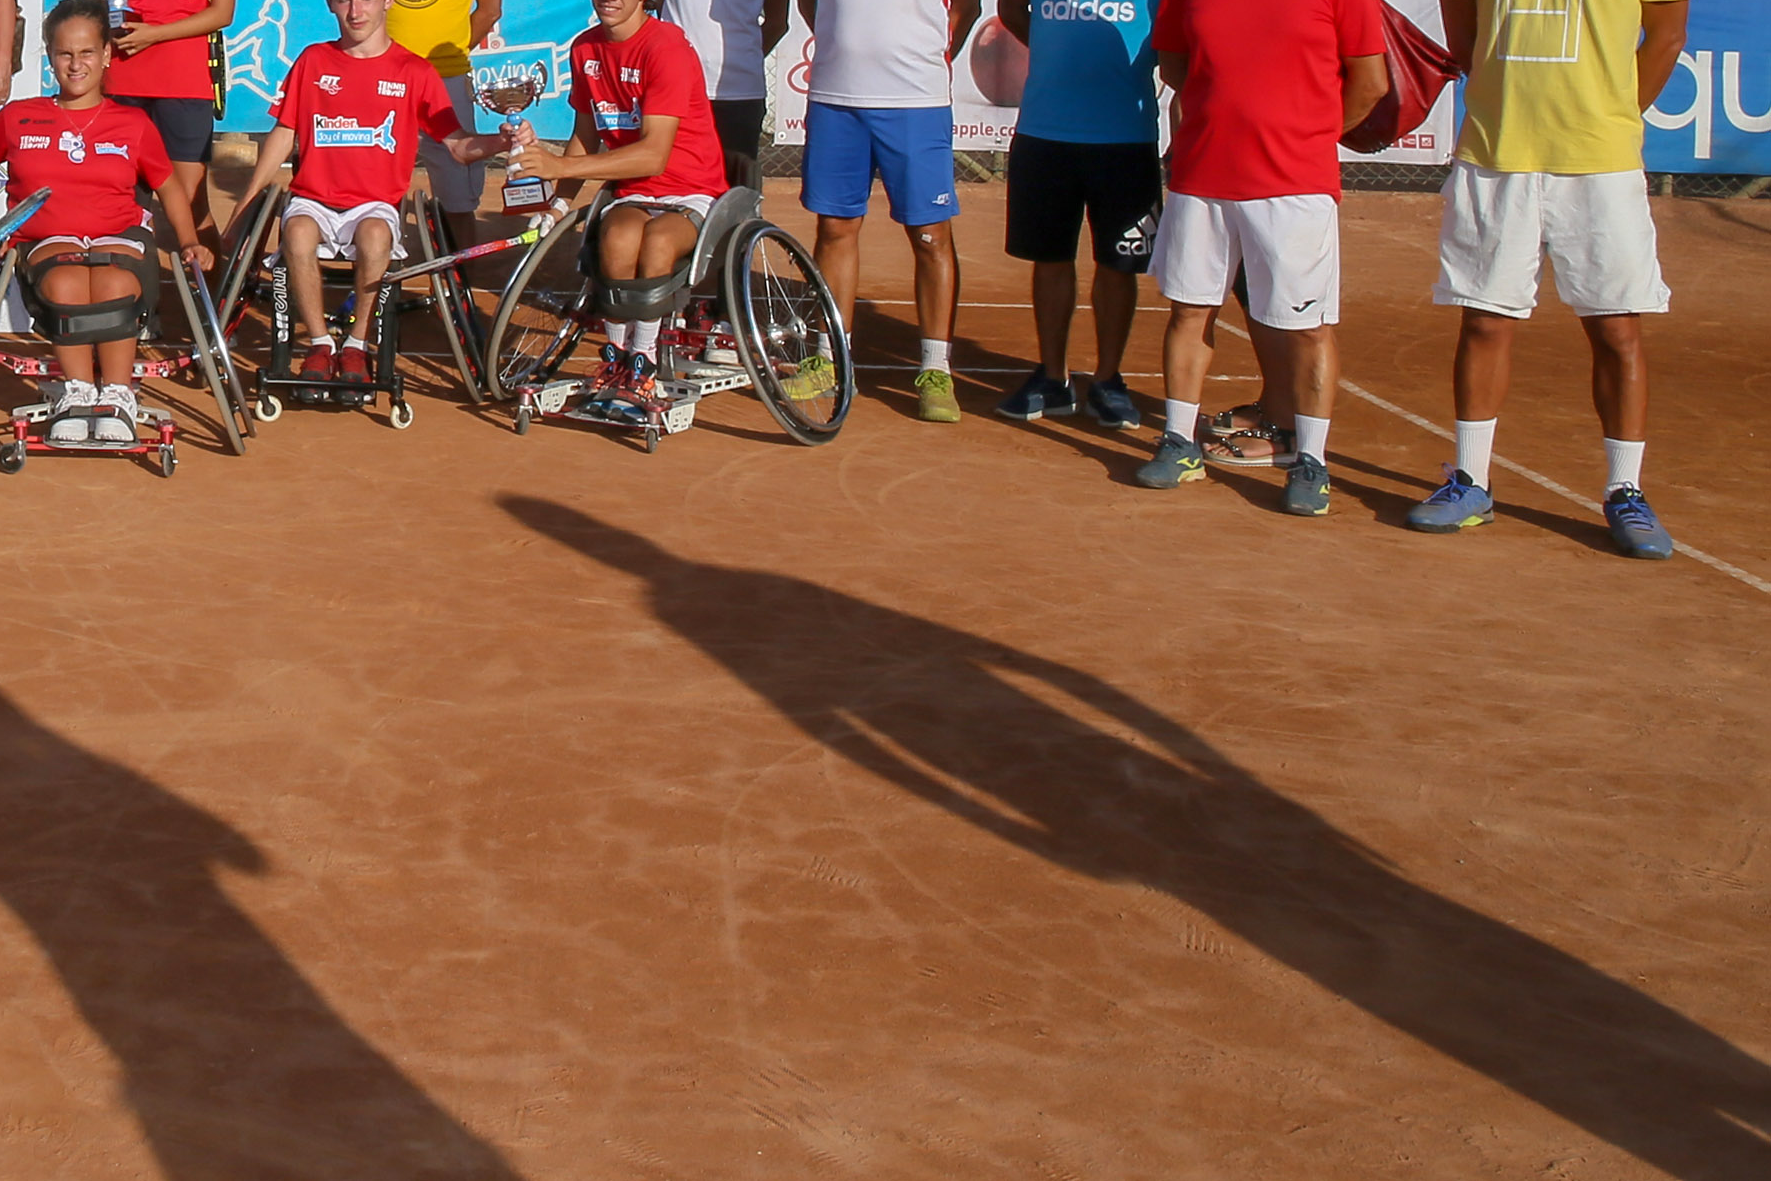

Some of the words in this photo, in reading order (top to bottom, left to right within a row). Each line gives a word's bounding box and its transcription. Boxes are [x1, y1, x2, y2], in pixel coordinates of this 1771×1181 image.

[319, 74, 341, 85] FIT
[377, 79, 406, 90] TENNIS
[1642, 50, 1771, 160] qu
[20, 135, 51, 144] TENNIS
[317, 132, 332, 143] Joy
[333, 132, 341, 141] of
[341, 133, 371, 143] moving
[1116, 235, 1152, 255] adi
